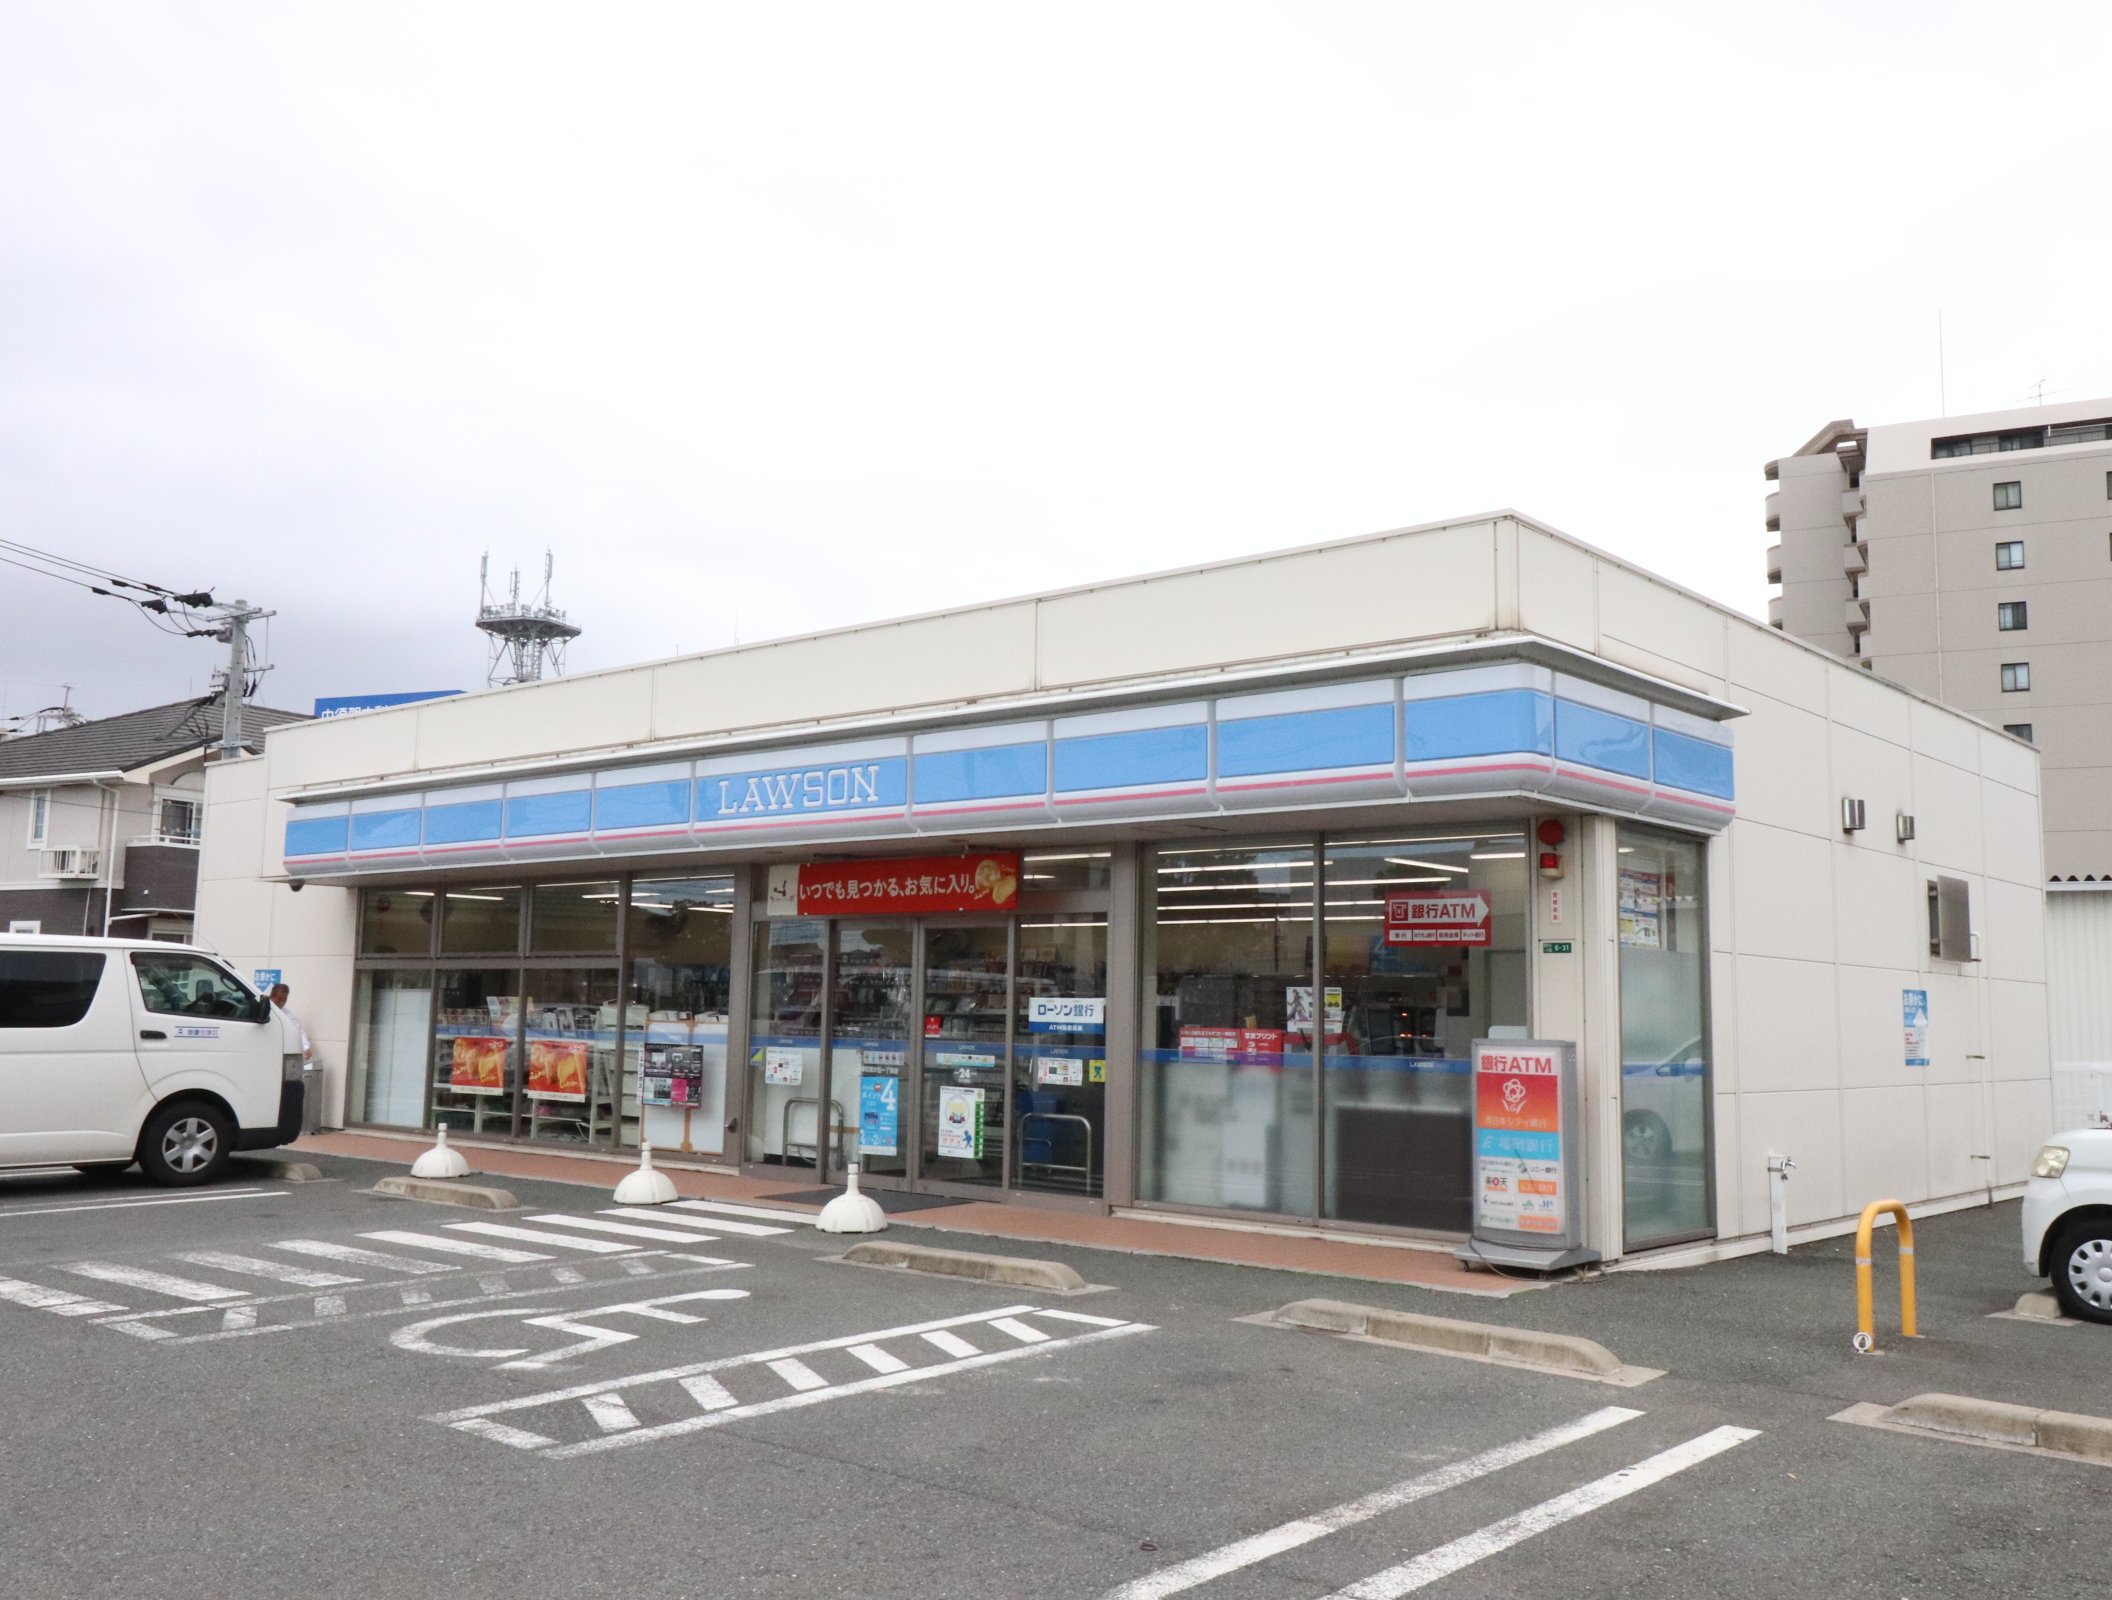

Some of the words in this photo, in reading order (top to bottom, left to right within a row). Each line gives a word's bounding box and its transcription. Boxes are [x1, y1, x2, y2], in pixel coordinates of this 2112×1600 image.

[718, 765, 880, 815] LAWSON
[799, 874, 976, 900] いつでも見つかる、お気に入り。
[1411, 903, 1476, 919] 銀行ATM
[1037, 1004, 1095, 1017] ローソン銀行
[1481, 1055, 1552, 1074] 銀行ATM
